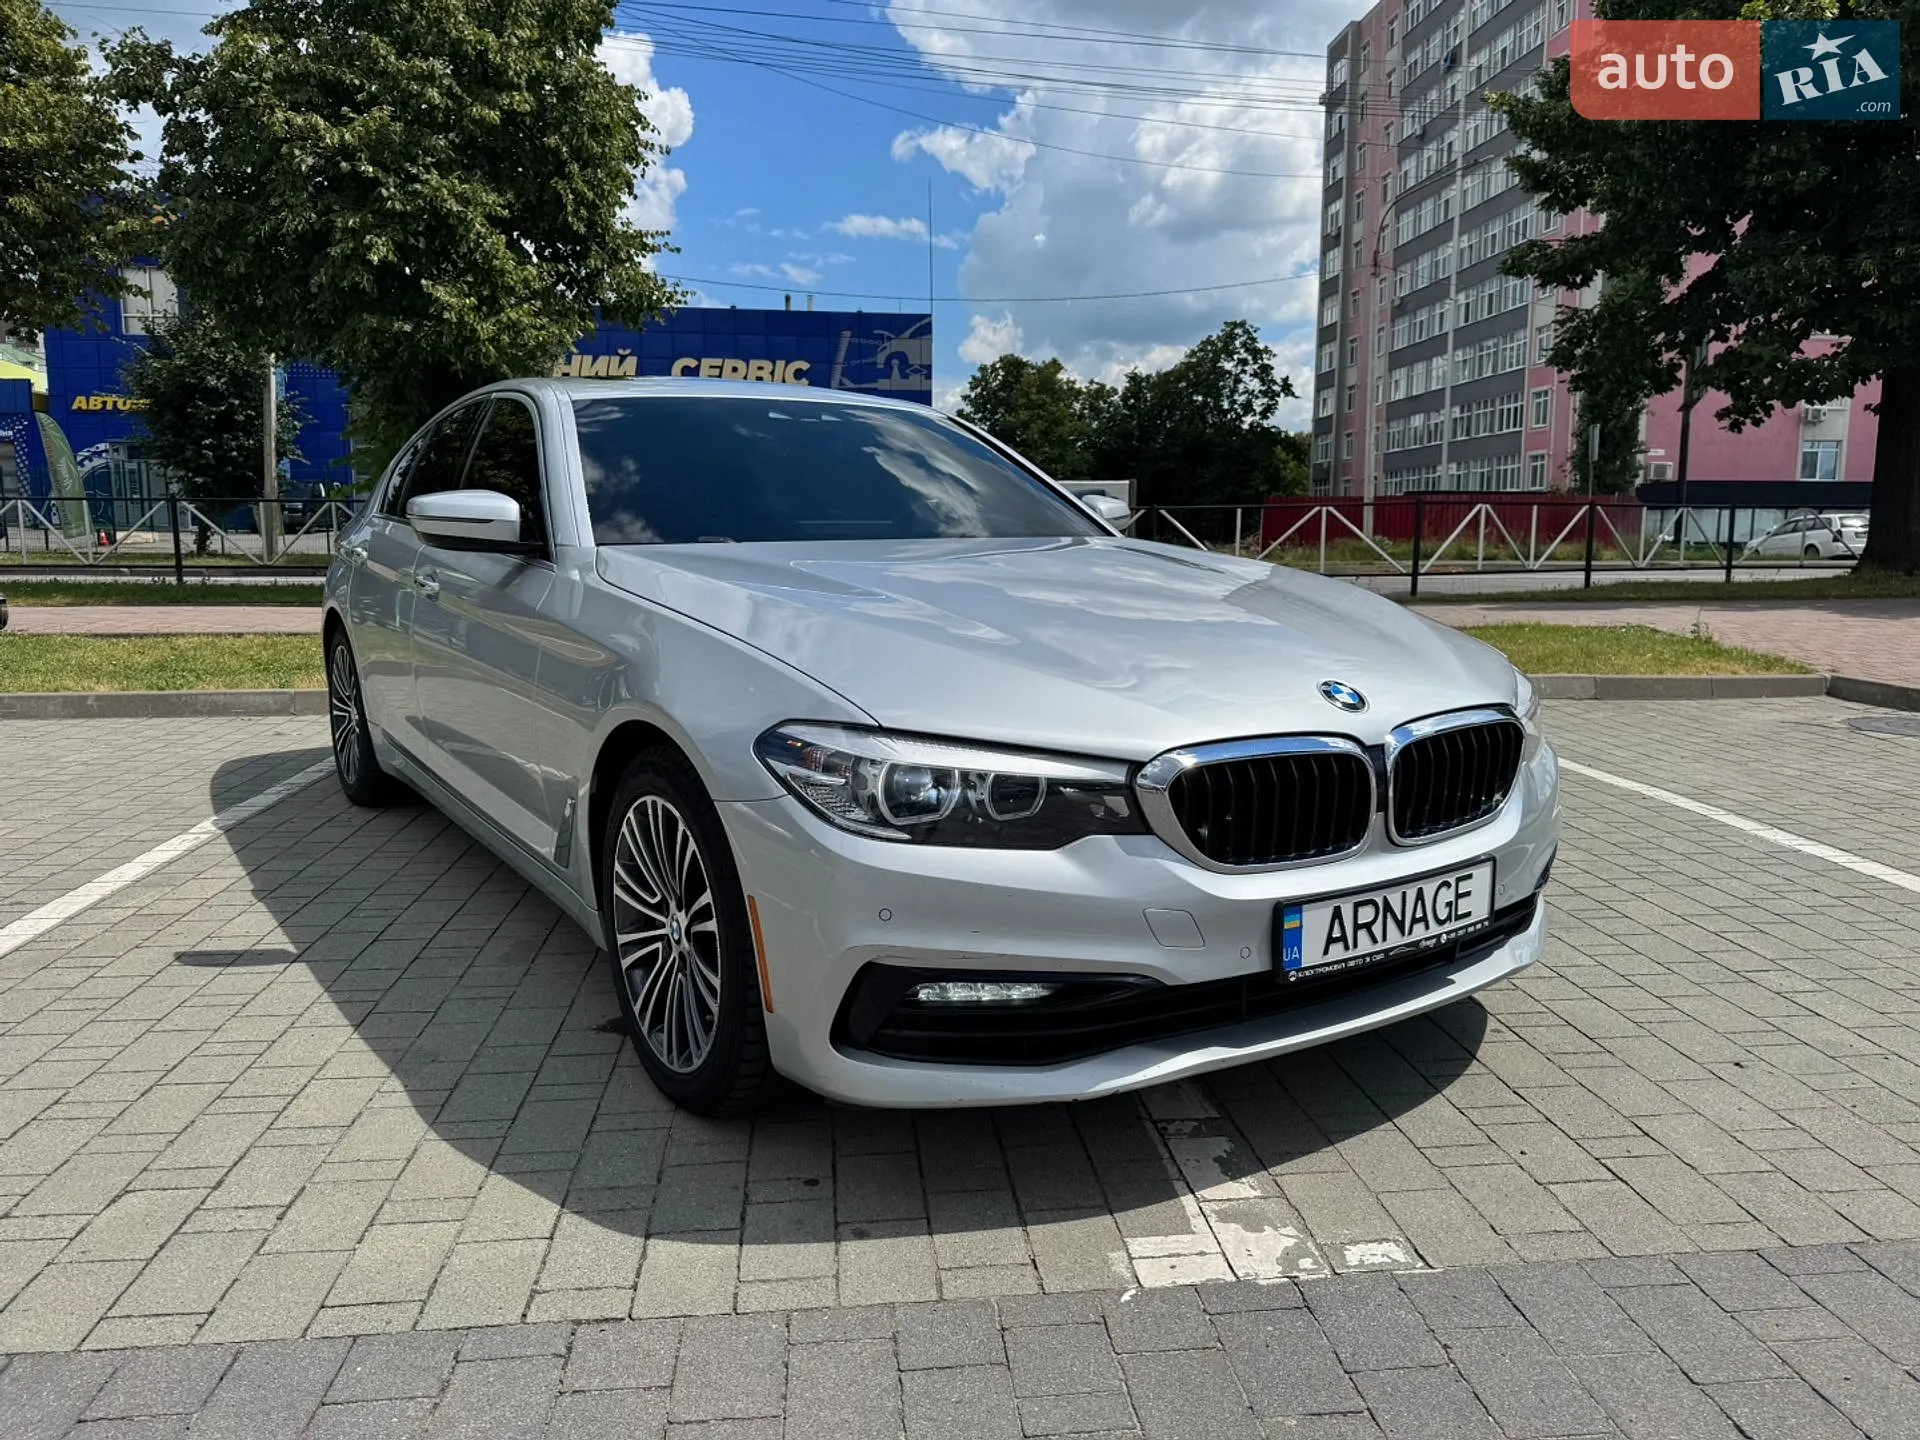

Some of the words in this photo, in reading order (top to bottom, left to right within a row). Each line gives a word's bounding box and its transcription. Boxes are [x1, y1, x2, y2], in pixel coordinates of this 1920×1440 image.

[671, 357, 811, 386] СЕРВІС
[1322, 872, 1474, 957] ARNAGE
[1283, 946, 1300, 961] UA
